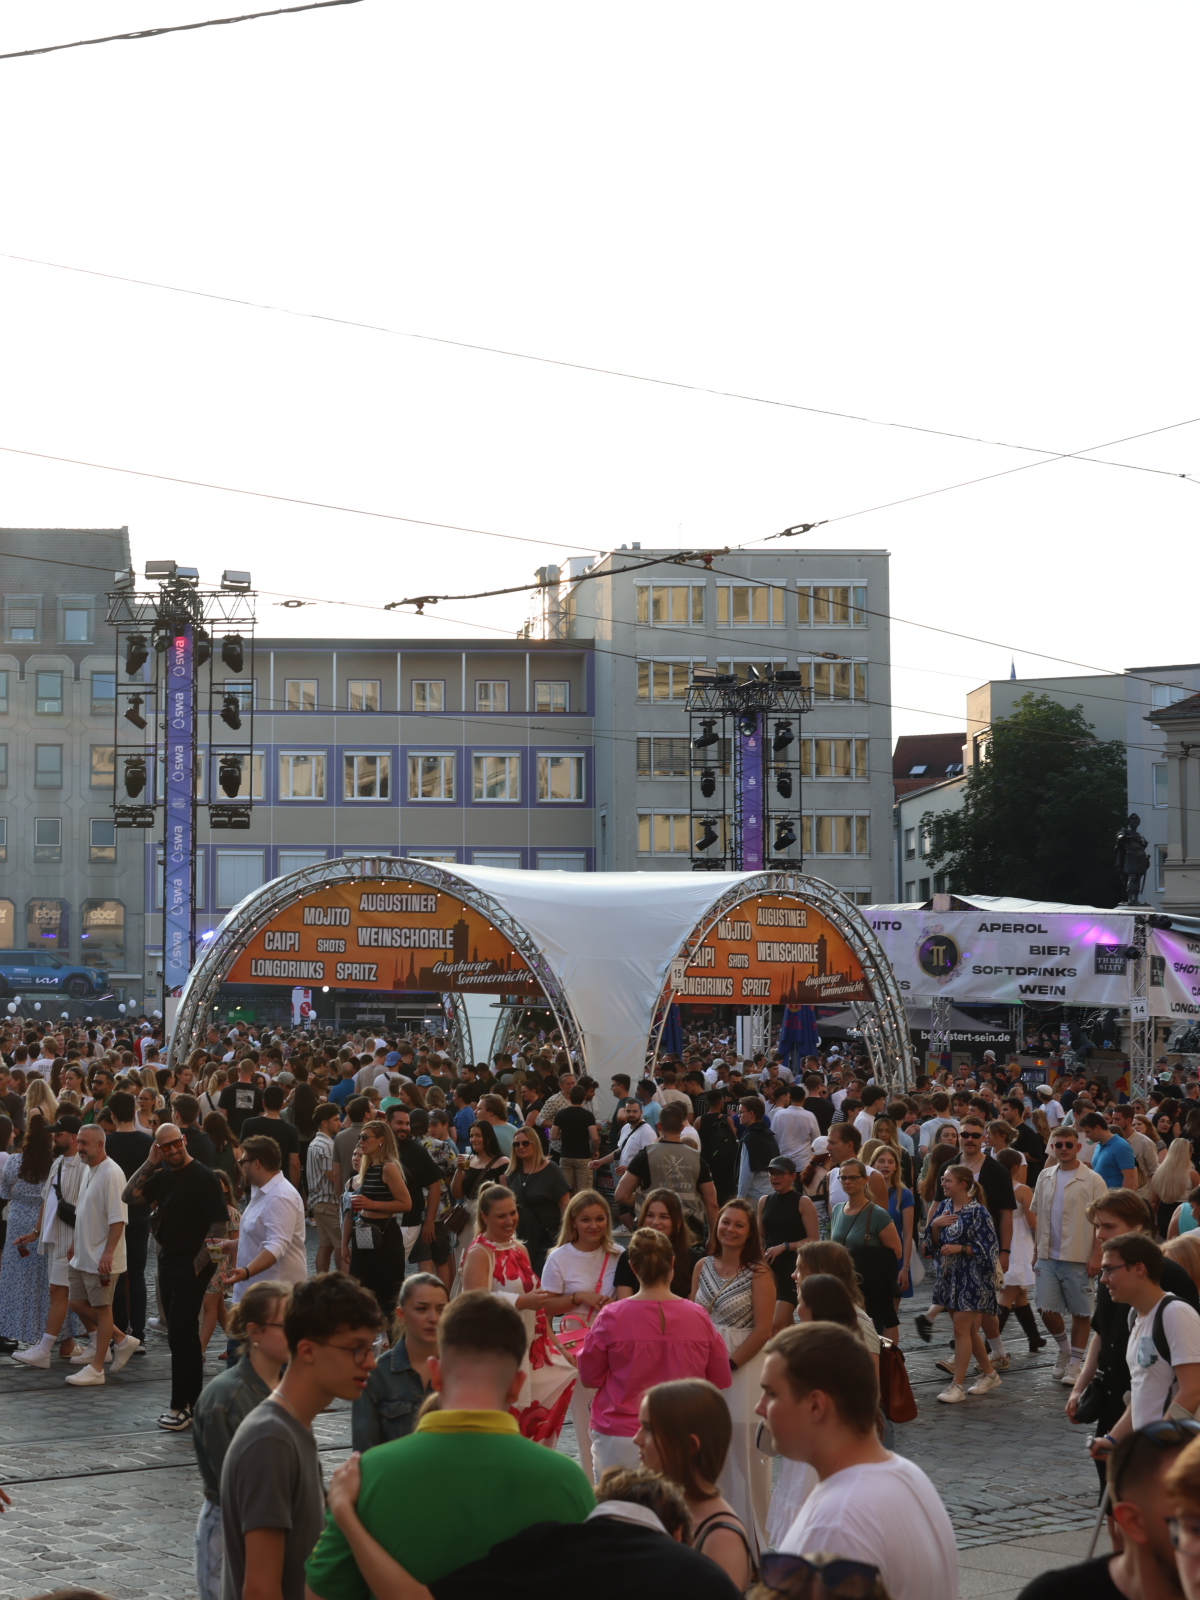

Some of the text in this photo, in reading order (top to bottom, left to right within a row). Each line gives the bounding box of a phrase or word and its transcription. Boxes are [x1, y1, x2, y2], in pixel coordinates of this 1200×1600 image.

[176, 640, 185, 664] swa
[175, 692, 184, 717] swa
[174, 745, 184, 770] swa
[174, 825, 183, 850] swa
[174, 878, 182, 903] swa
[359, 893, 436, 912] AUGUSTINER
[35, 907, 62, 918] eber
[90, 908, 117, 919] eber
[304, 906, 350, 926] MOJITO
[757, 907, 807, 927] AUGUSTINER
[718, 920, 751, 941] MOJITO
[872, 921, 902, 931] JITO
[978, 923, 1048, 934] APEROL
[173, 932, 182, 957] swa
[264, 931, 346, 952] CAIPI SHOTS
[357, 927, 454, 949] WEINSCHORLE
[757, 941, 818, 963] WEINSCHORLE
[1029, 945, 1071, 956] BIER
[251, 959, 378, 981] LONGDRINKS SPRITZ
[433, 960, 492, 977] Augsburger
[728, 954, 749, 968] SHOTS
[1174, 962, 1200, 975] SHOT
[456, 970, 533, 984] Sommernächte
[674, 969, 681, 978] 15
[805, 973, 842, 989] Augsburger
[972, 966, 1077, 977] SOFTDRINKS
[679, 977, 771, 996] ONGDRINKS SPRITZ
[821, 981, 864, 996] Sommernächte
[1018, 984, 1066, 995] WEIN
